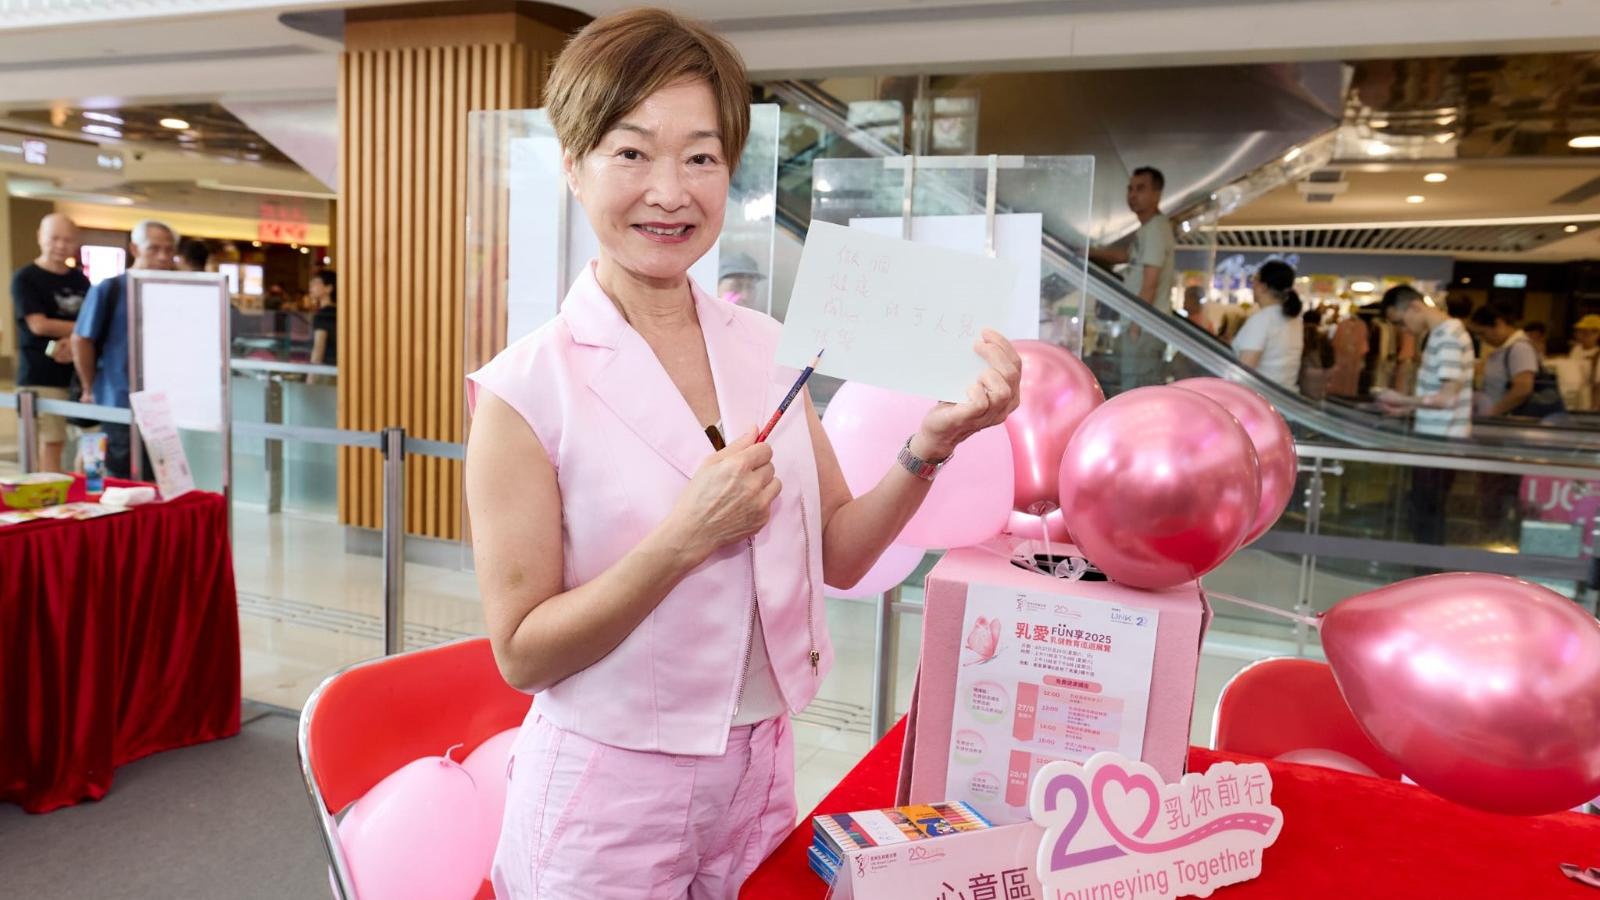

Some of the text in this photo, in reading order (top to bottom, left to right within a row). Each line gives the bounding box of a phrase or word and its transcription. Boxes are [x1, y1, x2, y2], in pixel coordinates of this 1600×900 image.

[1015, 622, 1049, 643] 乳愛
[1164, 774, 1265, 831] 乳你前行
[1173, 848, 1256, 885] Together
